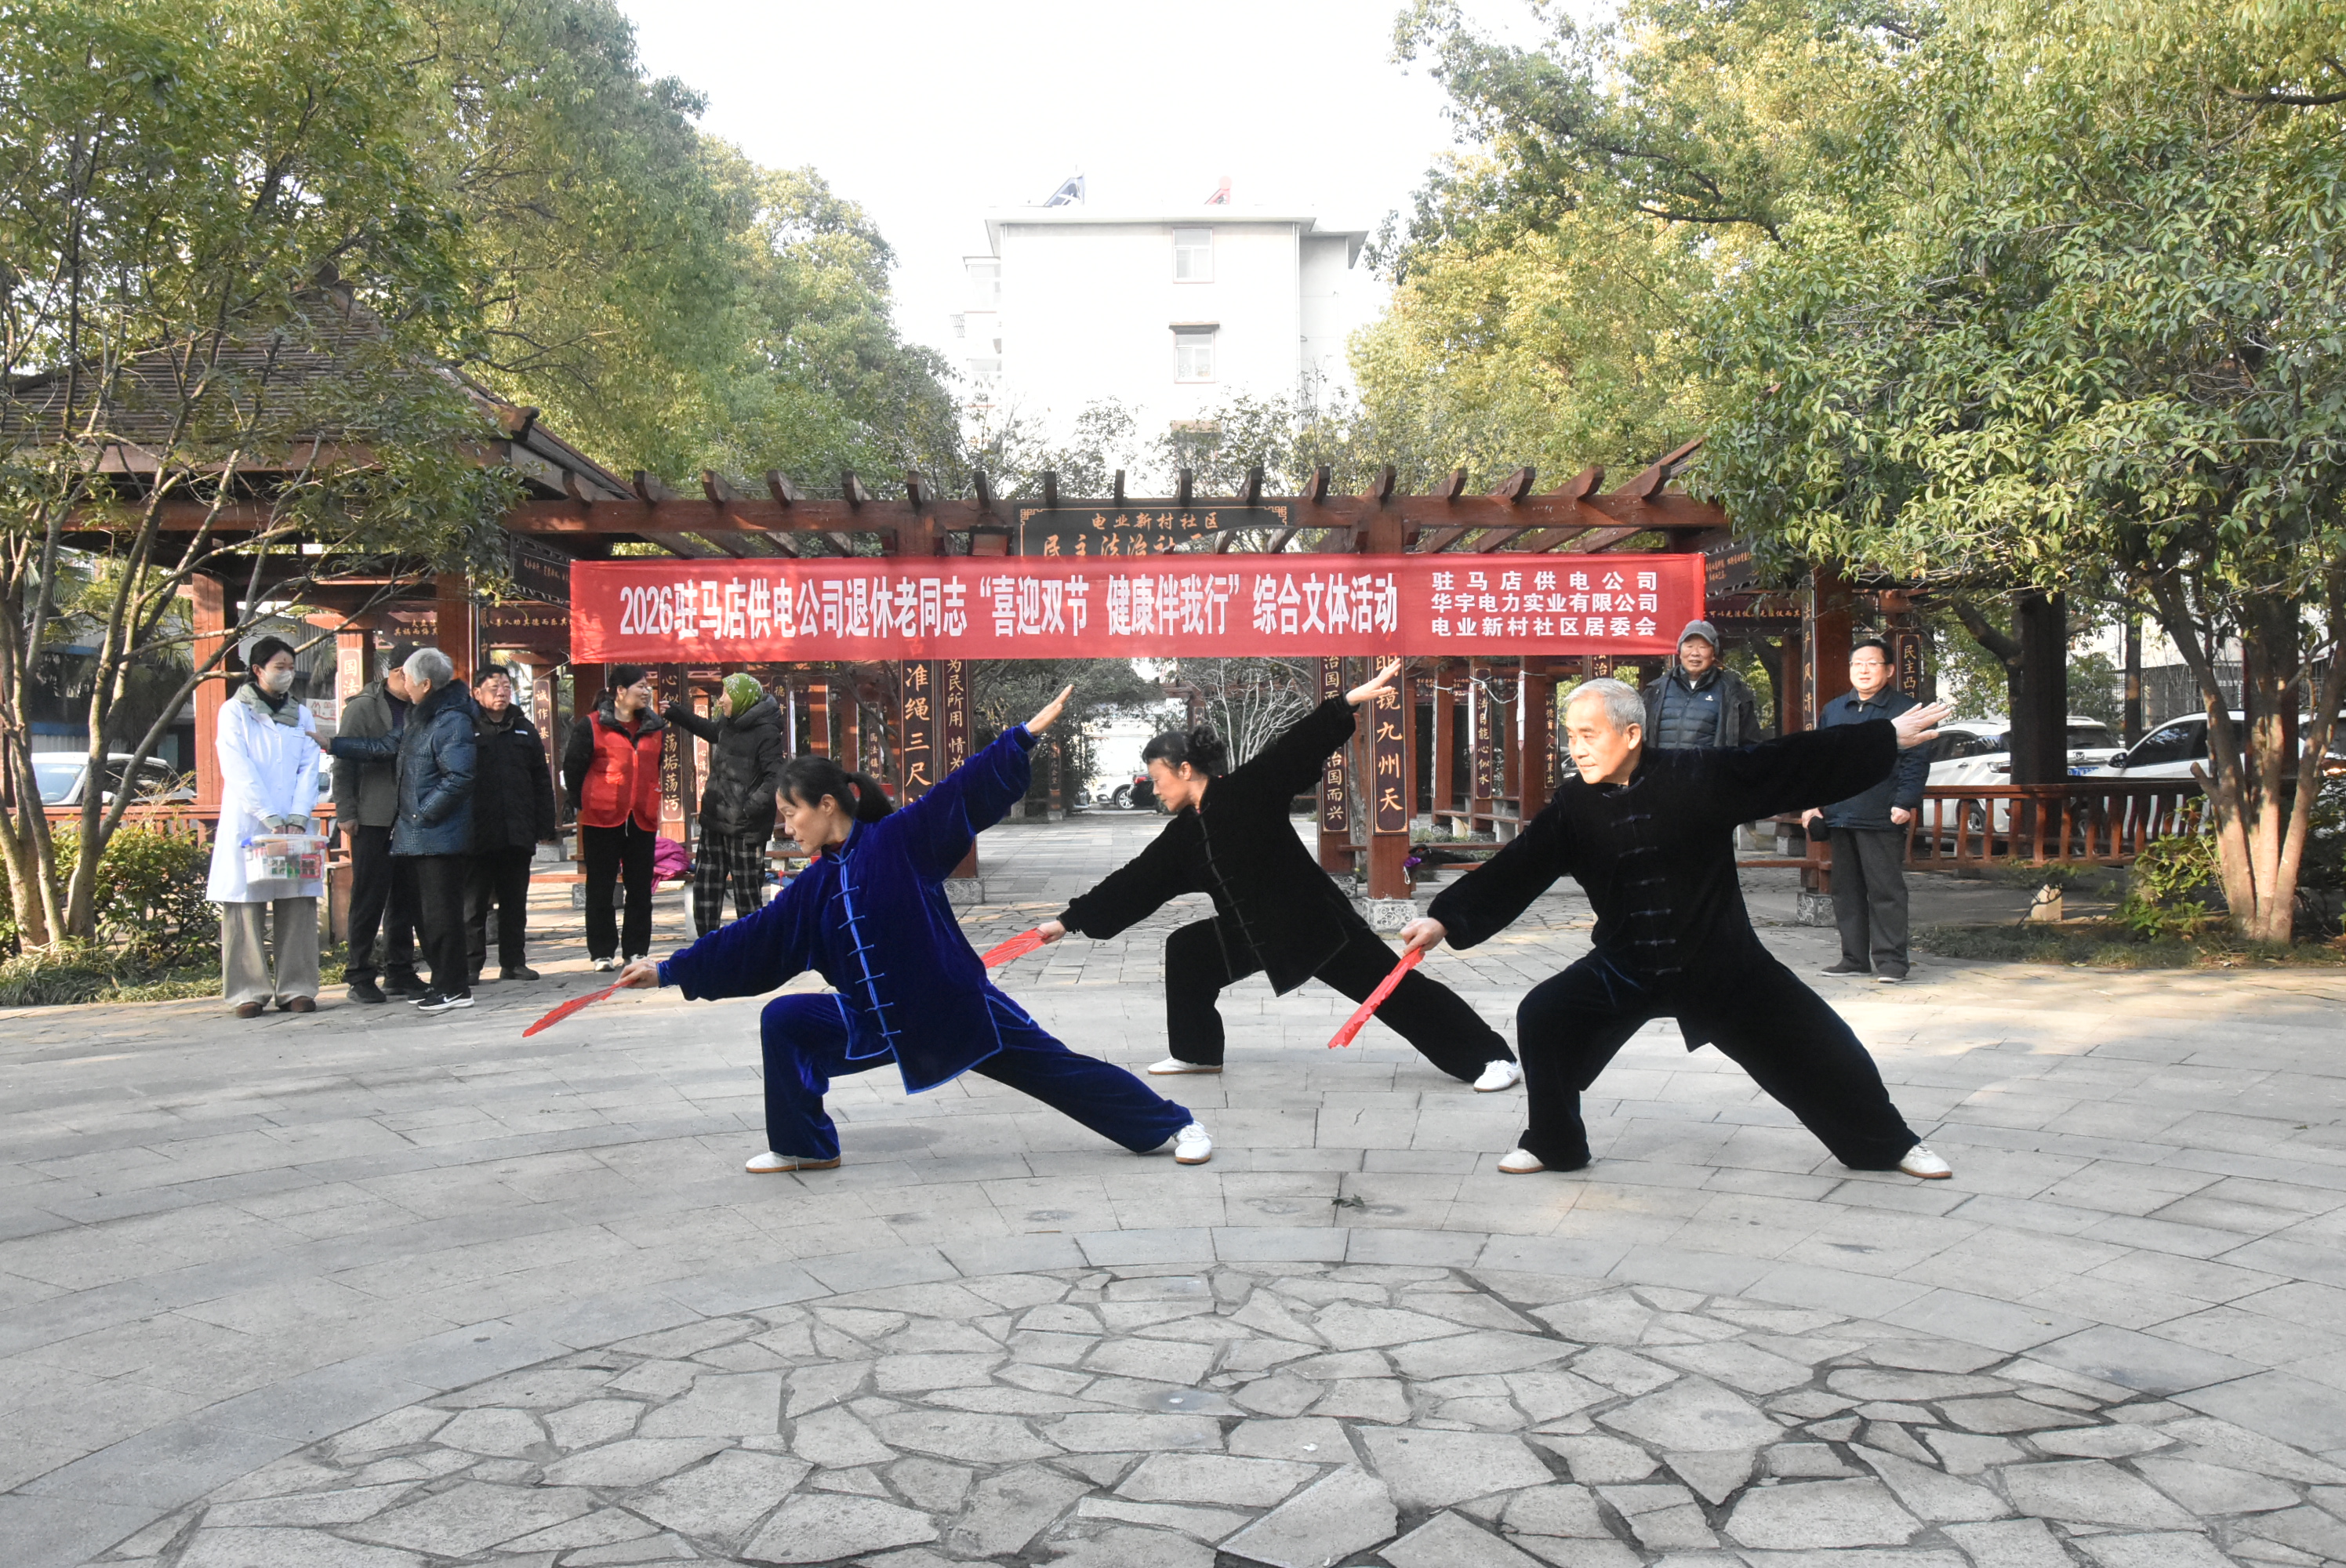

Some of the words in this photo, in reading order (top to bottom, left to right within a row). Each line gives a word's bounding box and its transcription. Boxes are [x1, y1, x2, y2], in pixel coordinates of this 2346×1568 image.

[1091, 511, 1218, 530] 电业新村社区
[1043, 532, 1203, 556] 民主法治社
[1432, 570, 1657, 590] 驻马店供电公司
[1431, 592, 1658, 614] 华宇电力实业有限公司
[1432, 616, 1657, 637] 电业新村社区居委会
[905, 663, 933, 802] 准绳三尺
